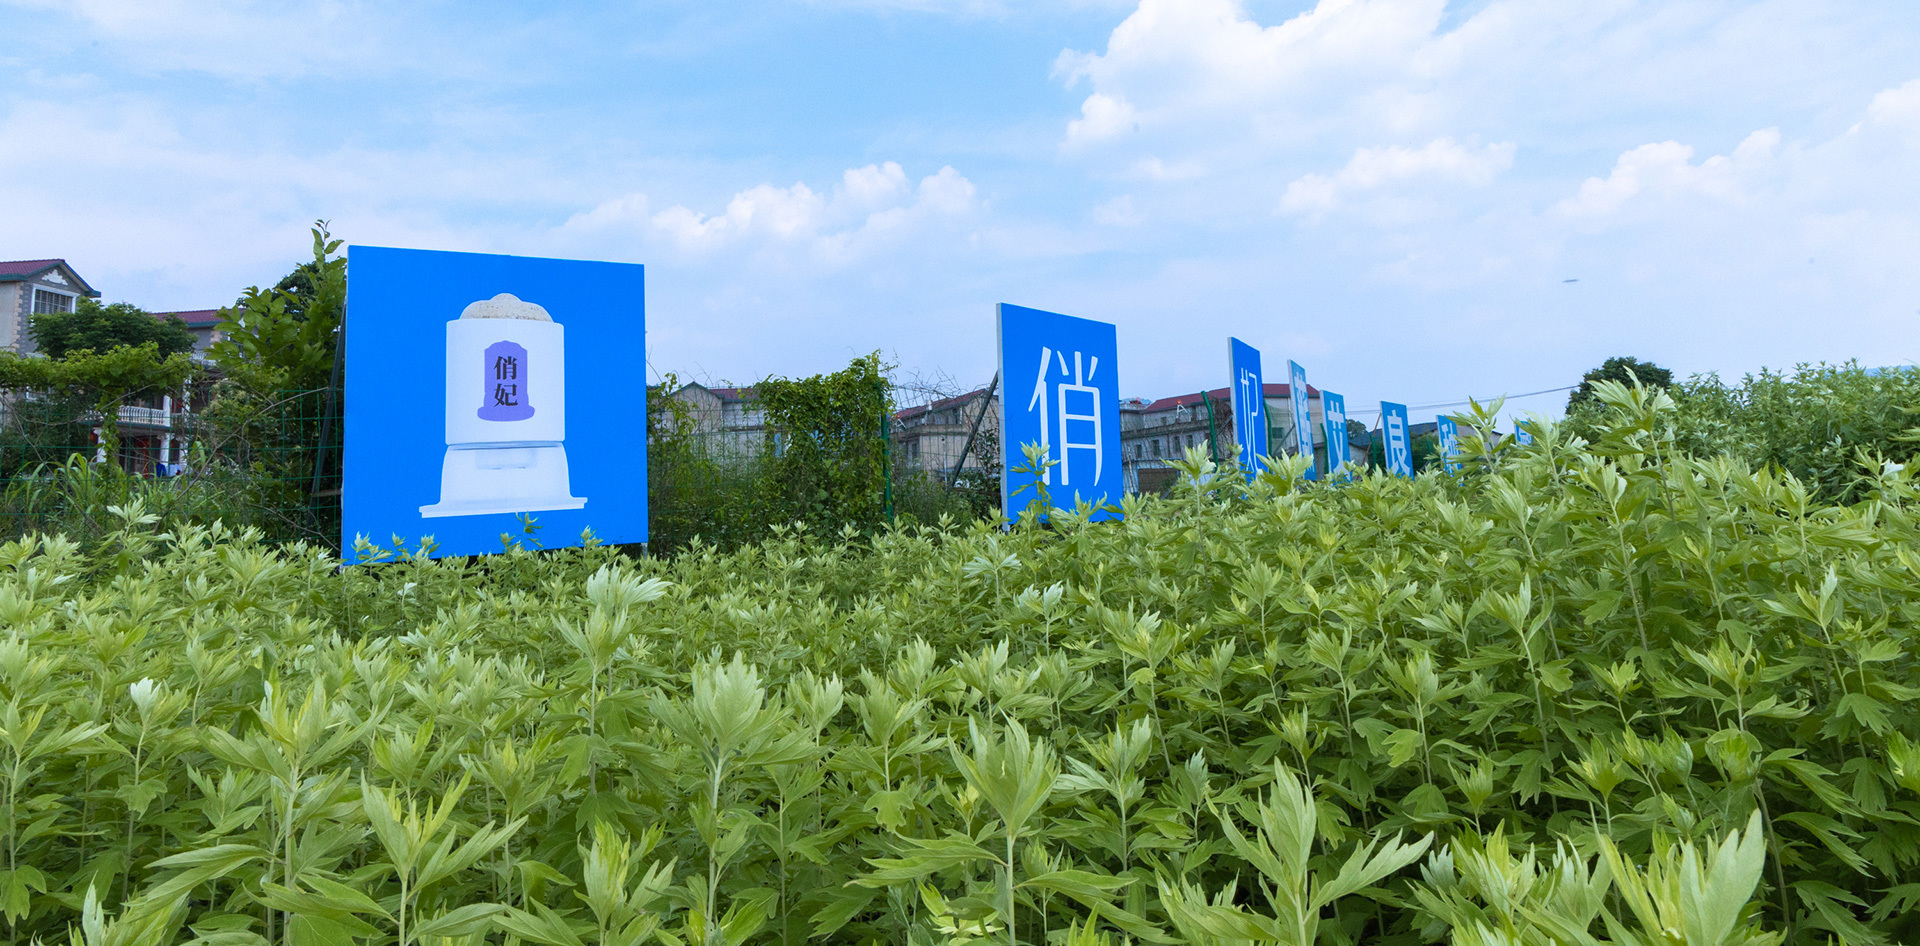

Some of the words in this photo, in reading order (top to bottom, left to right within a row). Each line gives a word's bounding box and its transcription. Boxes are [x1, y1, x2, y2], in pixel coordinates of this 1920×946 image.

[494, 356, 518, 407] 俏妃
[1028, 346, 1102, 487] 俏
[1241, 367, 1264, 474] 妃
[1327, 400, 1352, 481] 艾
[1387, 409, 1411, 478] 良
